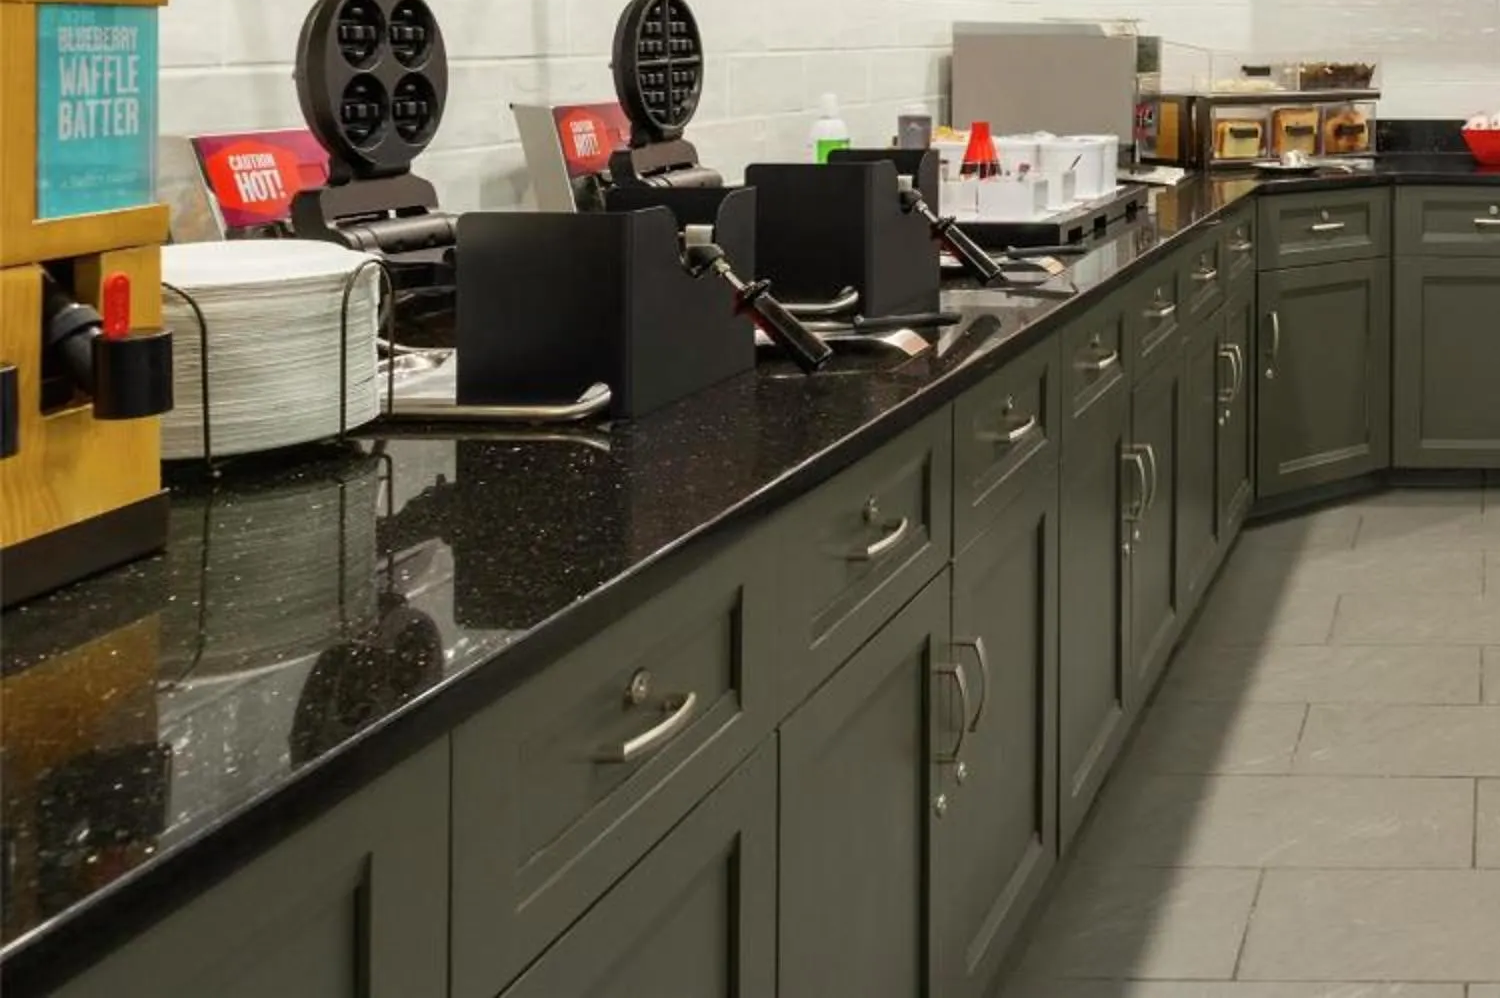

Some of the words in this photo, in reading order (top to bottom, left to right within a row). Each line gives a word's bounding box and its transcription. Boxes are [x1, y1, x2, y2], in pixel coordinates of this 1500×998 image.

[59, 55, 140, 97] WAFFLE
[58, 98, 140, 141] BATTER
[233, 169, 287, 203] HOT!
